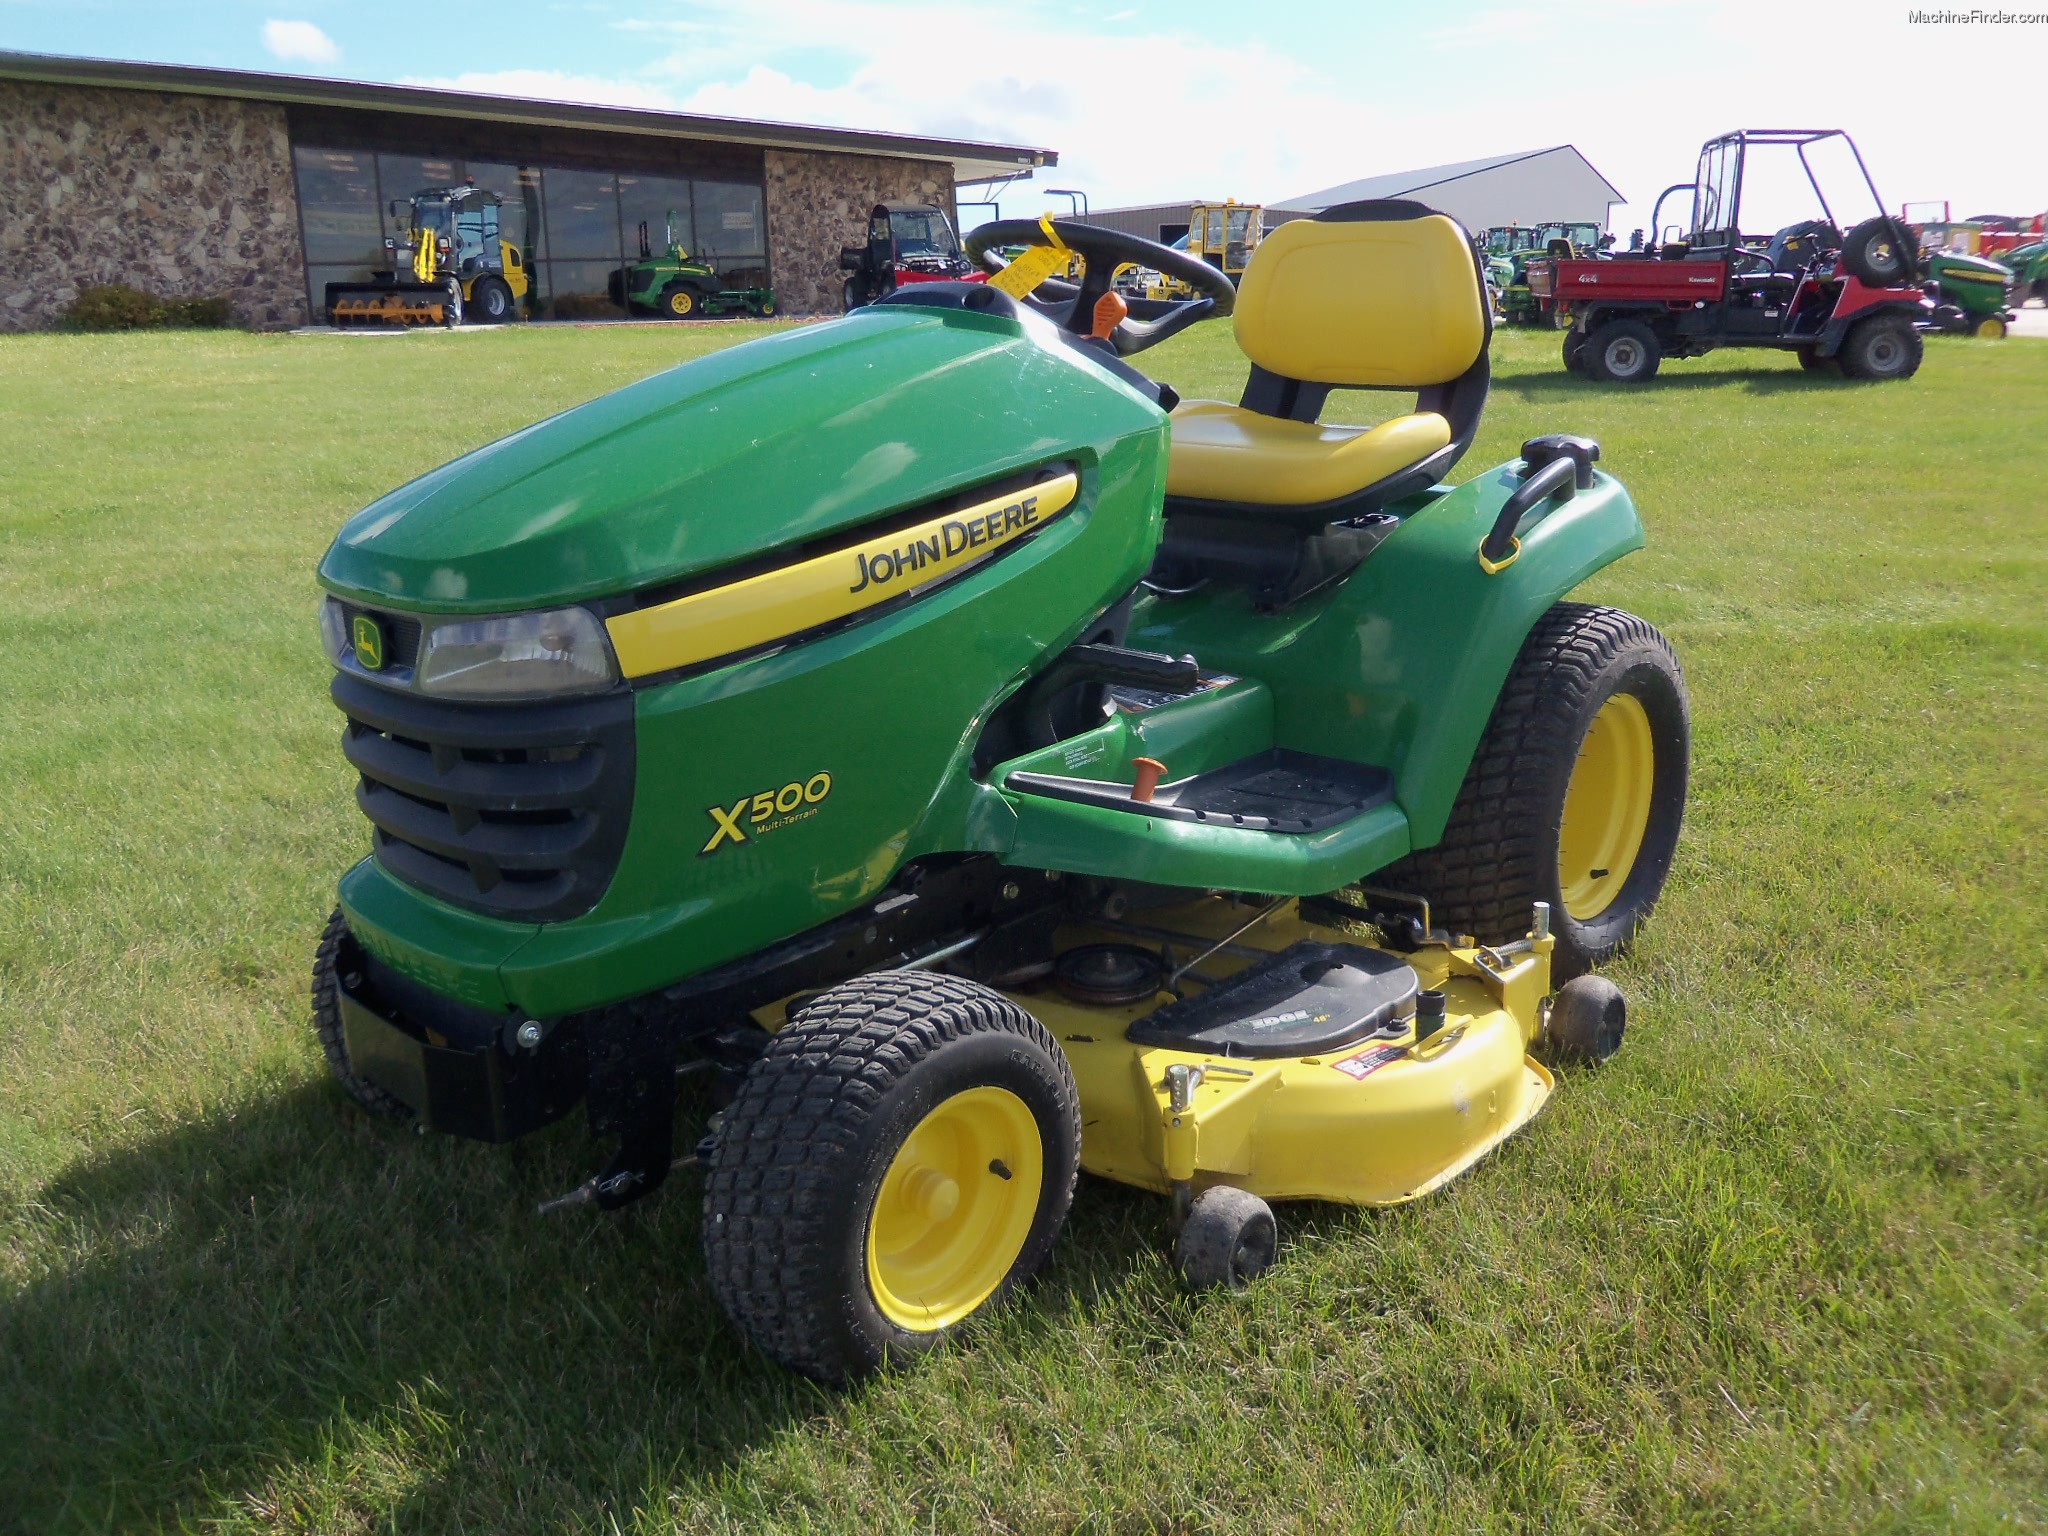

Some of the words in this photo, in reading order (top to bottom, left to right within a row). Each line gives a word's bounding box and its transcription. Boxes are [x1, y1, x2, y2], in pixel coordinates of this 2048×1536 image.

[1578, 274, 1598, 283] 4x4
[850, 534, 941, 594] JOHN
[942, 496, 1039, 558] DEERE
[699, 772, 832, 855] X500
[756, 807, 819, 835] Multi-Terrain
